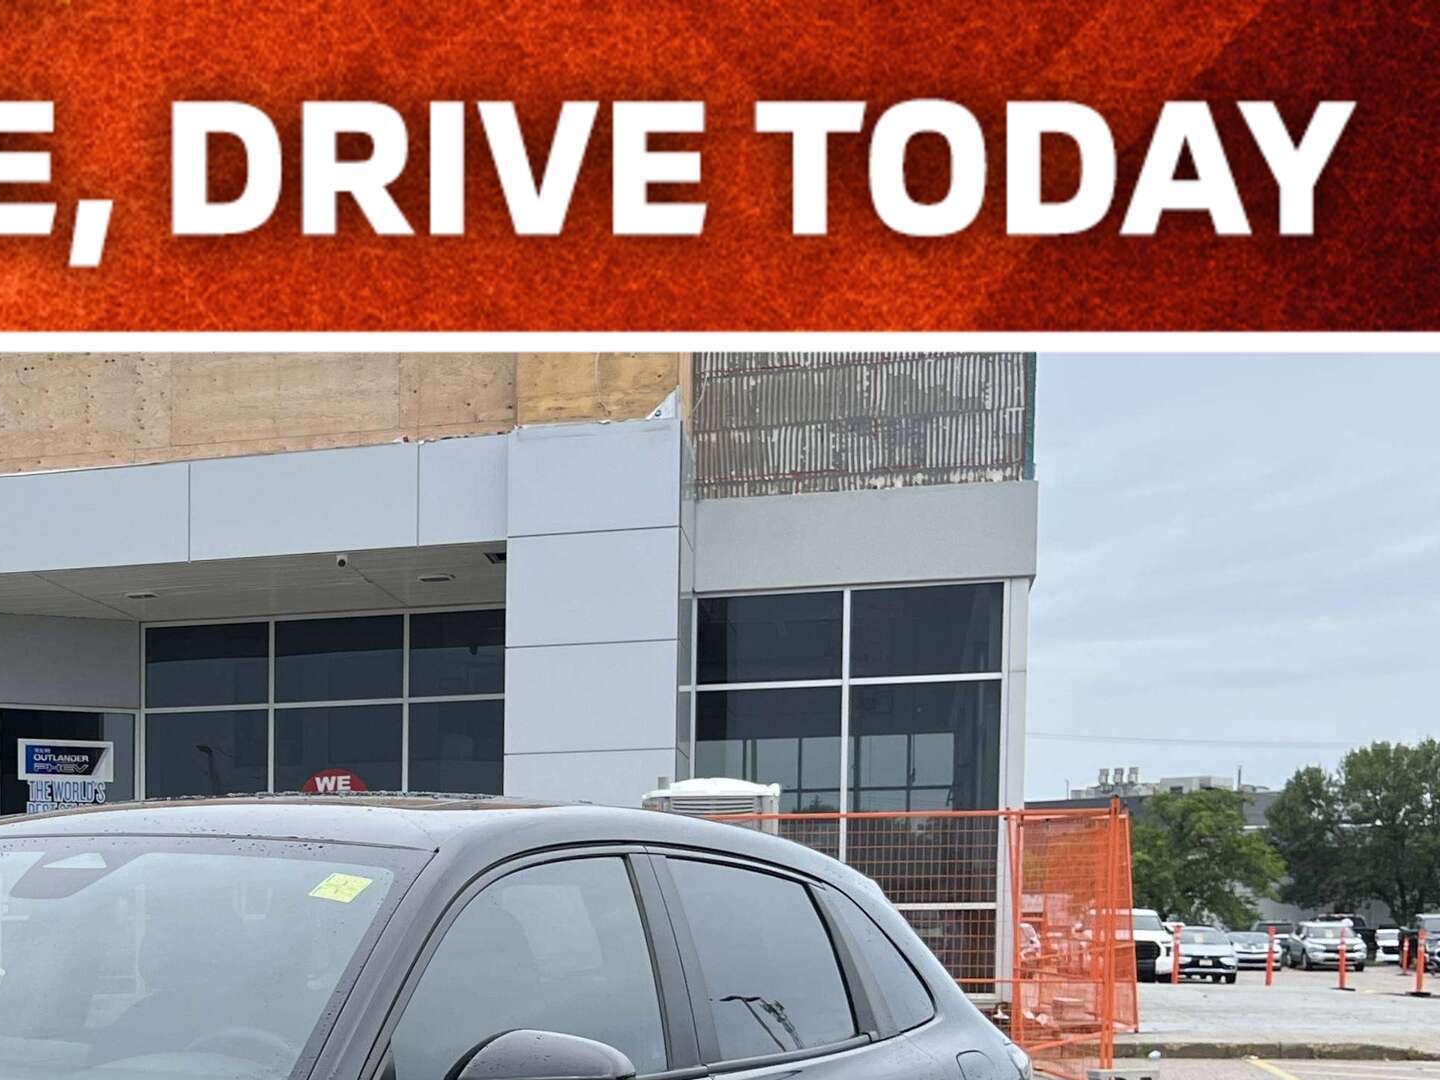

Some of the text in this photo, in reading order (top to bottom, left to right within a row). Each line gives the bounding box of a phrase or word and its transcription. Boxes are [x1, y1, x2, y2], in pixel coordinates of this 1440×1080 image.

[33, 753, 89, 762] OUTLANDER
[27, 780, 106, 804] THE WORLD'S
[314, 775, 351, 793] WE
